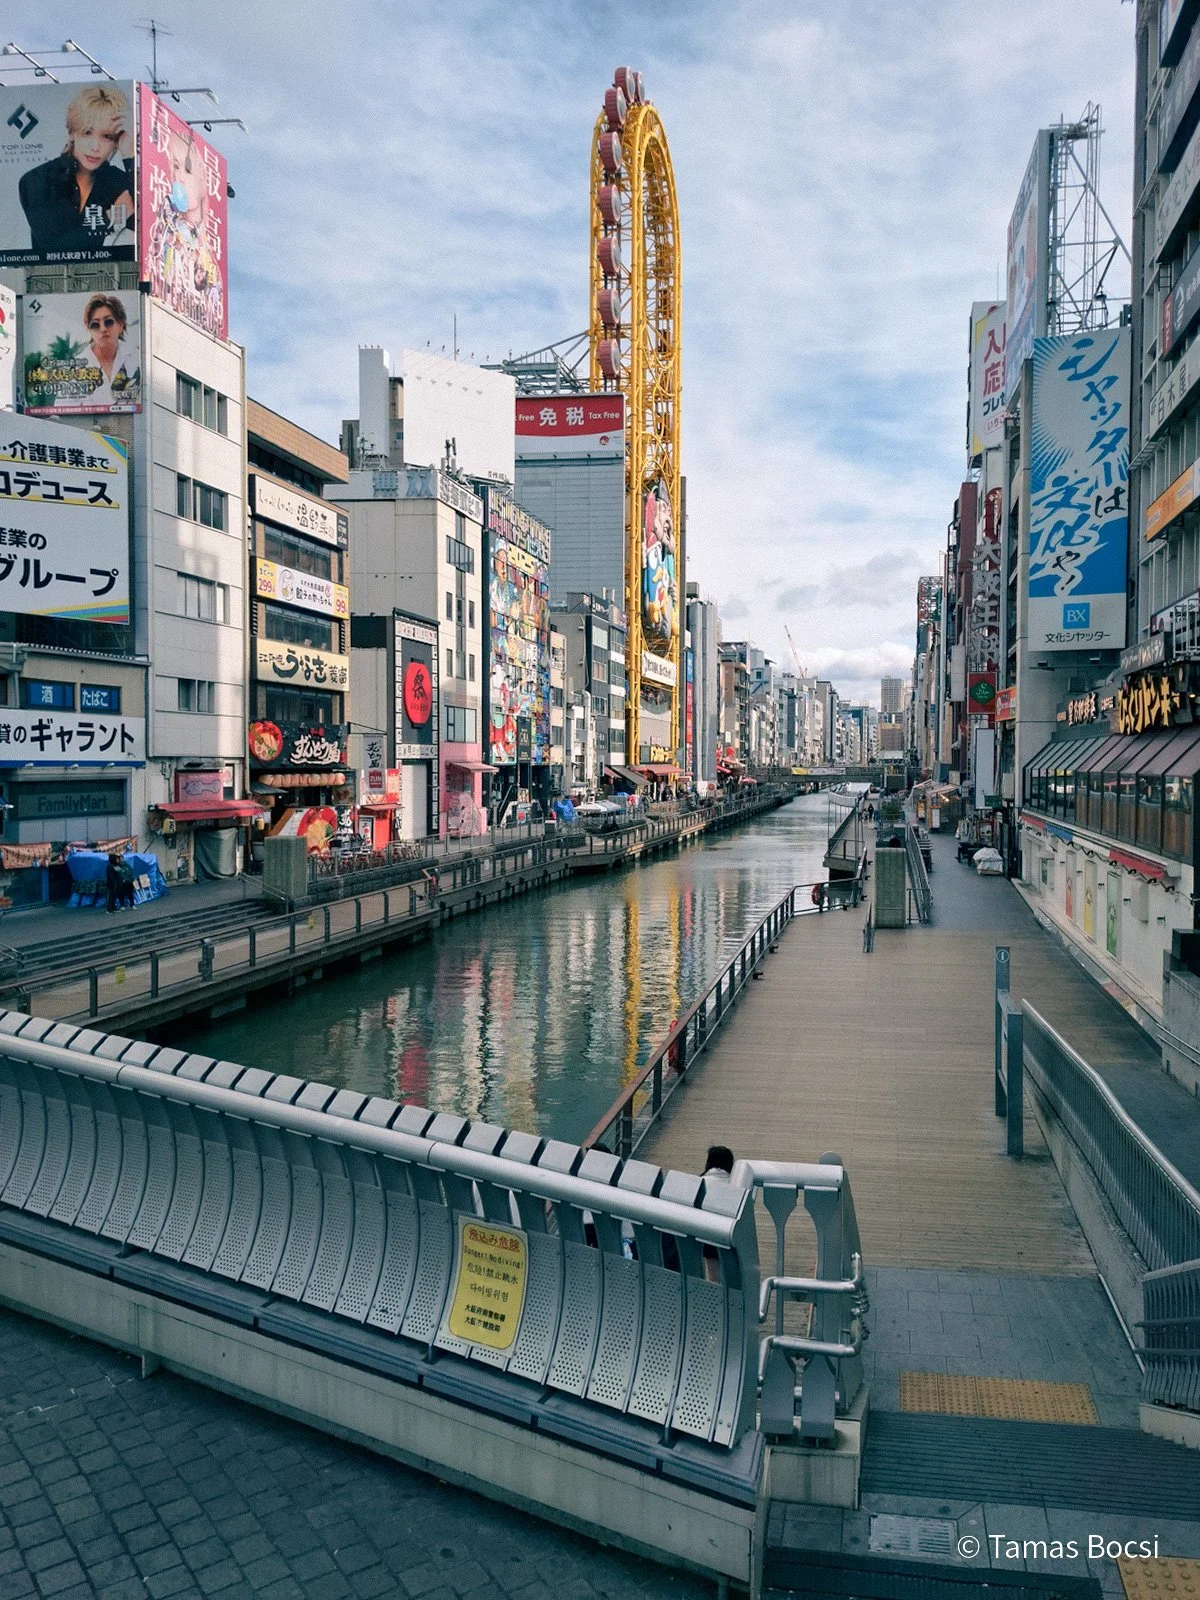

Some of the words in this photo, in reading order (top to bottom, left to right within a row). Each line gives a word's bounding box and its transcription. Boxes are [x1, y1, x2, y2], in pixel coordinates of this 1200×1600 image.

[203, 146, 222, 261] 最高
[984, 321, 1007, 363] 入
[983, 356, 1006, 398] 応
[539, 406, 585, 426] 免税
[589, 412, 601, 420] Tax
[604, 411, 620, 419] Free
[1067, 609, 1085, 622] BX
[1045, 631, 1111, 643] 文化シャッター
[272, 648, 328, 683] うなぎ
[42, 686, 53, 704] 酒
[82, 689, 108, 707] たばこ
[291, 735, 340, 763] ずんどう屋
[38, 795, 107, 812] FamilyMart
[468, 1227, 521, 1253] 飛込み危険
